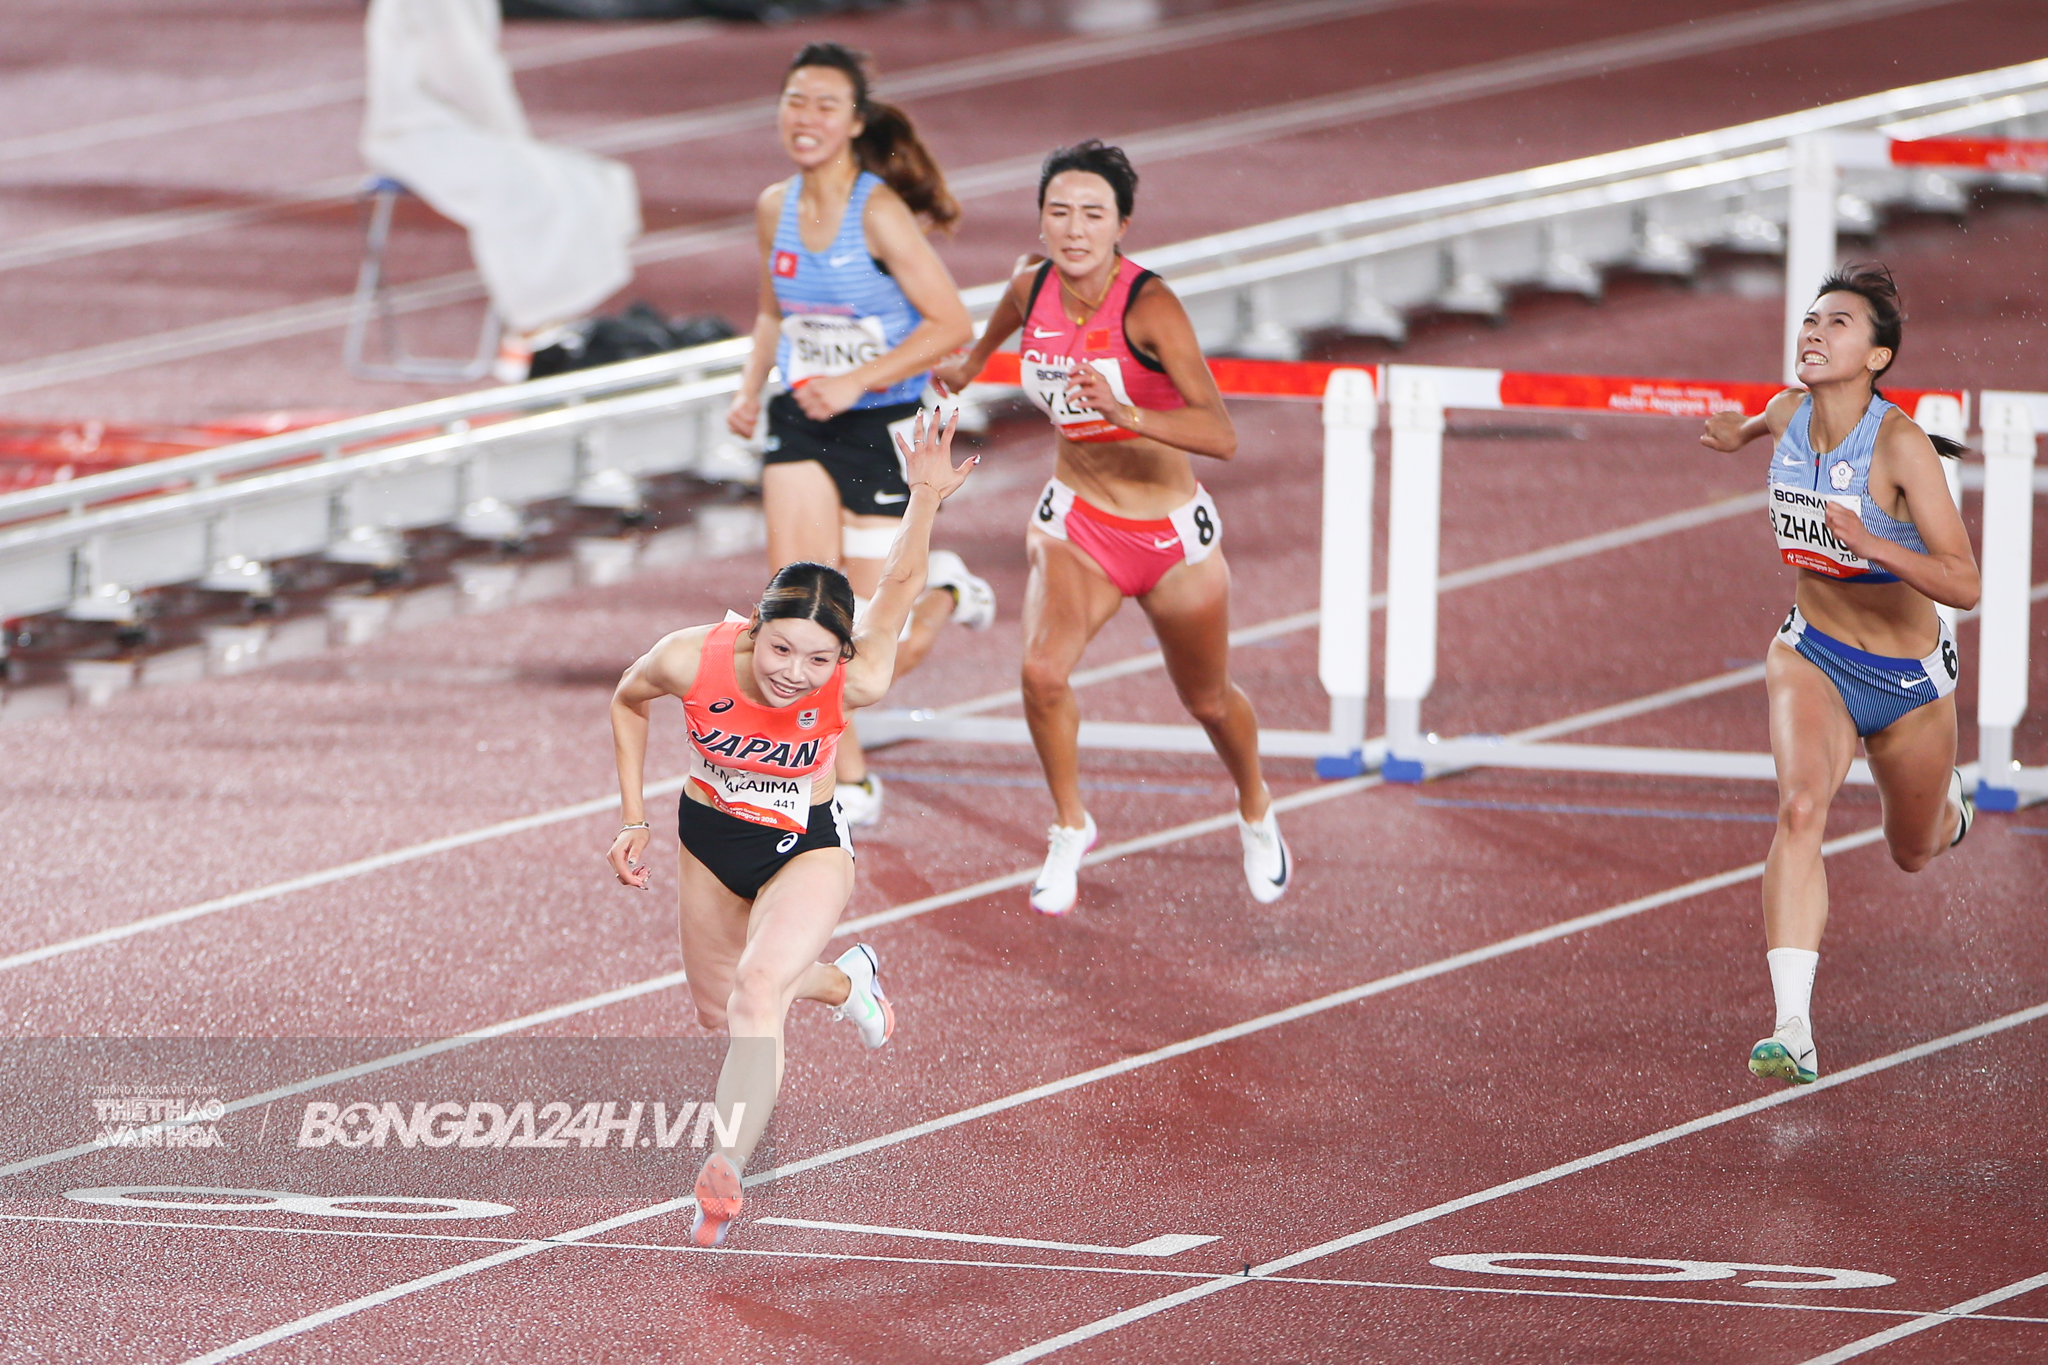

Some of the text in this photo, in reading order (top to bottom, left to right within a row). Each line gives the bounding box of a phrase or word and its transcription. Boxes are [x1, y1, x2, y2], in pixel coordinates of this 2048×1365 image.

[1039, 391, 1096, 415] Y.L
[1799, 506, 1825, 518] TECHNOL
[1194, 505, 1214, 546] 8
[1839, 553, 1859, 562] 718
[1942, 640, 1957, 680] 6
[691, 729, 821, 768] JAPAN
[773, 799, 795, 810] 441
[761, 816, 778, 824] 2026
